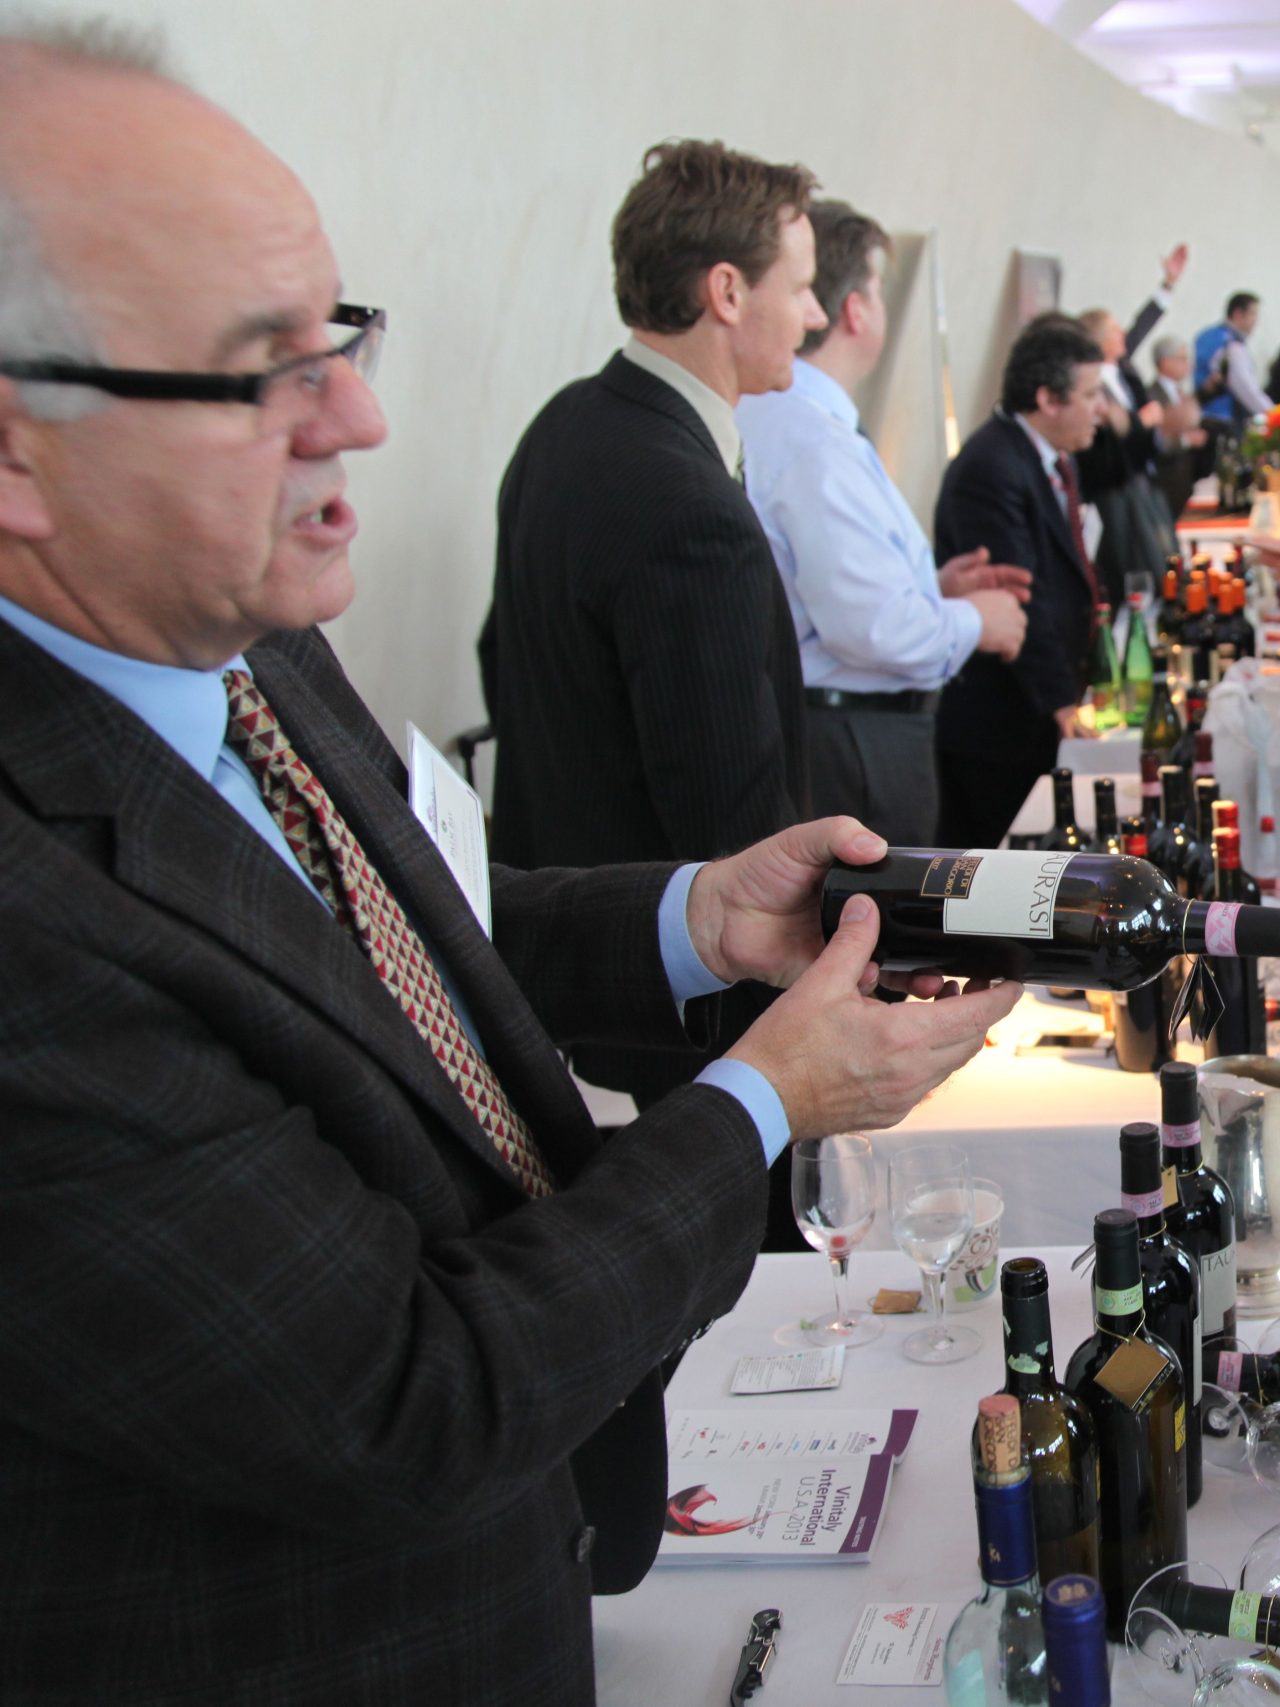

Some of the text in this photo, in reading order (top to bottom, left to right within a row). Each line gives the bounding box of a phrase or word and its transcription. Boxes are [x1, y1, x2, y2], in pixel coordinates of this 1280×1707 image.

[782, 1515, 806, 1541] 2013
[800, 1469, 837, 1546] International
[821, 1486, 851, 1532] Vinitaly
